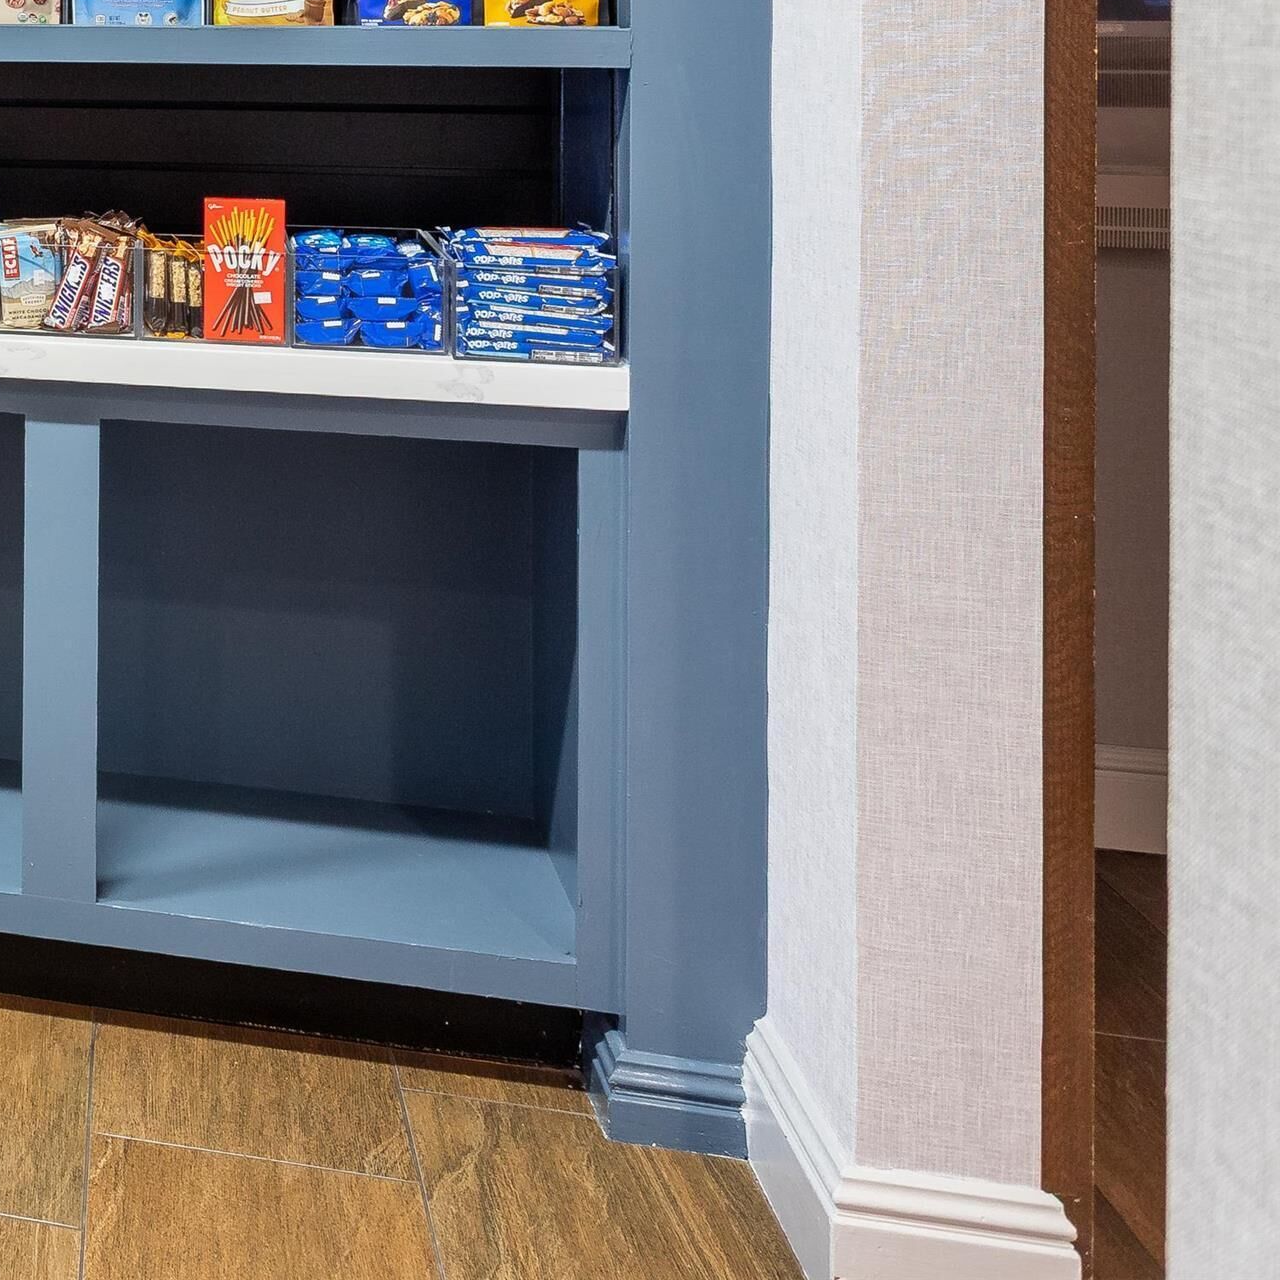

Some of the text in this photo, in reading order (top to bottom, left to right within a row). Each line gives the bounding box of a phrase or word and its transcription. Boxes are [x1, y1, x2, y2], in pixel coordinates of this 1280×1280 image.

[232, 5, 287, 14] PEANUT BUTTER
[94, 258, 120, 323] SNICERS
